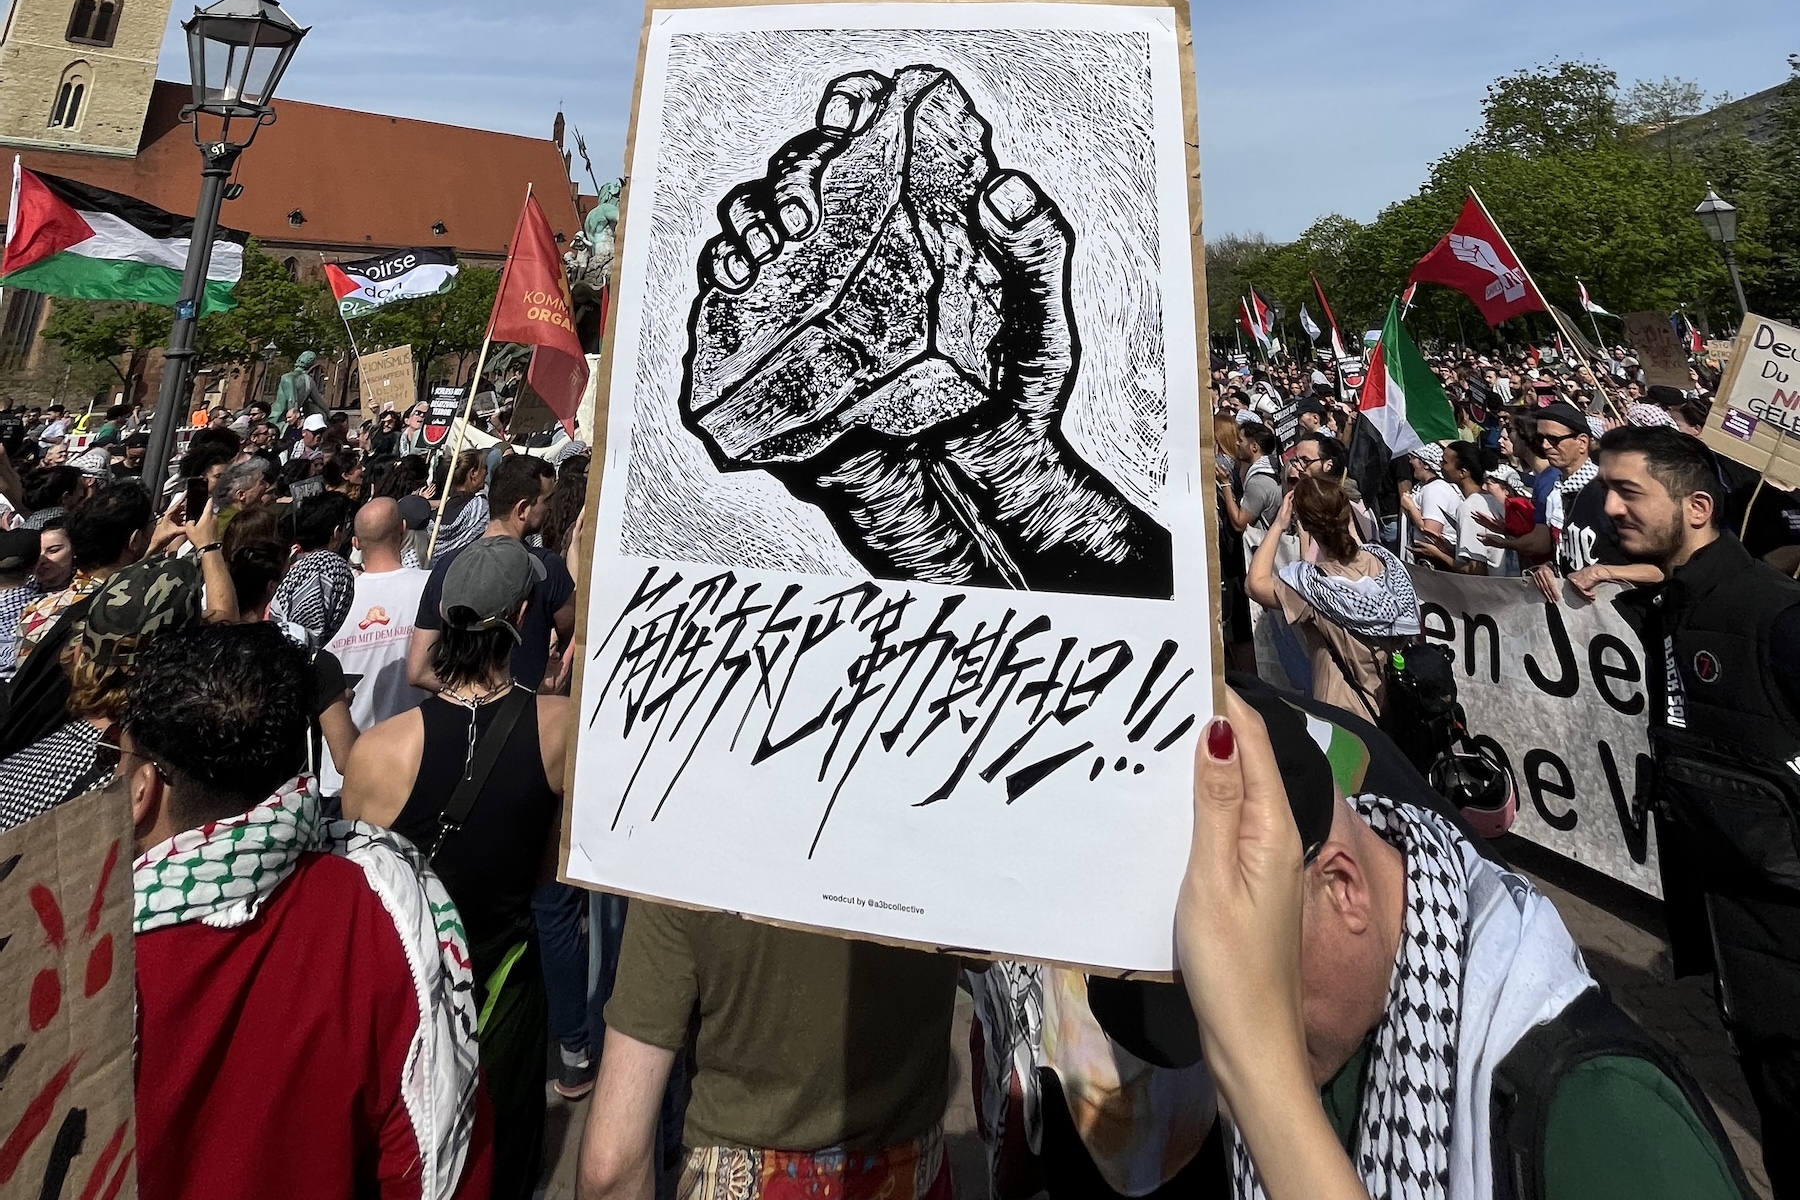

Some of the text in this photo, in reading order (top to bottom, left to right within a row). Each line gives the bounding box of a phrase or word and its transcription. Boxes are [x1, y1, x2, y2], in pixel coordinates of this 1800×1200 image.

[211, 143, 226, 156] 97
[347, 253, 417, 280] oirse
[1760, 360, 1789, 383] Du
[358, 631, 374, 644] MIT
[375, 628, 393, 641] DEM
[1663, 634, 1681, 693] BLACK
[822, 893, 925, 915] woodcut by @a3bcollective
